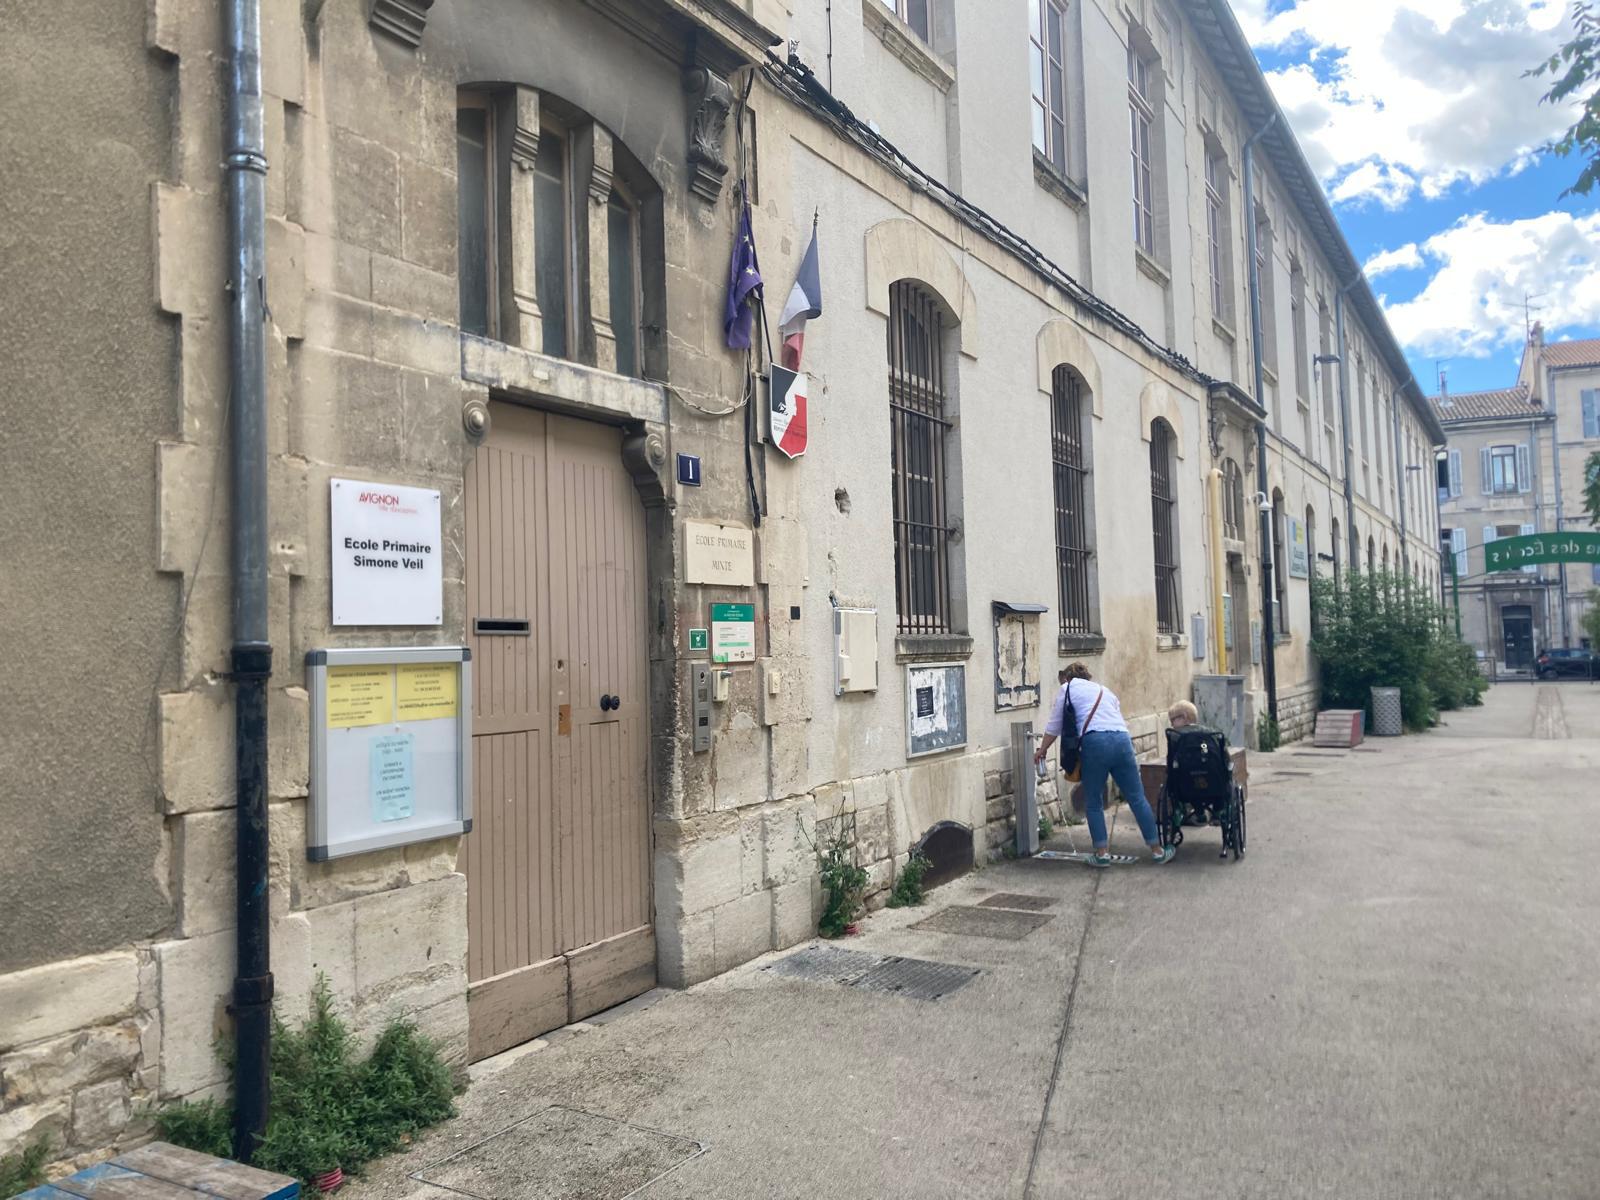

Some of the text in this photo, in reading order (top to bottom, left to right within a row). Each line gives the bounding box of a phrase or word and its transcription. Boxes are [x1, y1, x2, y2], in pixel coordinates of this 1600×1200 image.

[687, 459, 694, 480] 1
[359, 491, 399, 505] AVIGNON
[344, 537, 432, 554] Ecole Primaire
[717, 537, 747, 550] PRIMAIRE
[353, 555, 424, 570] Simone Veil
